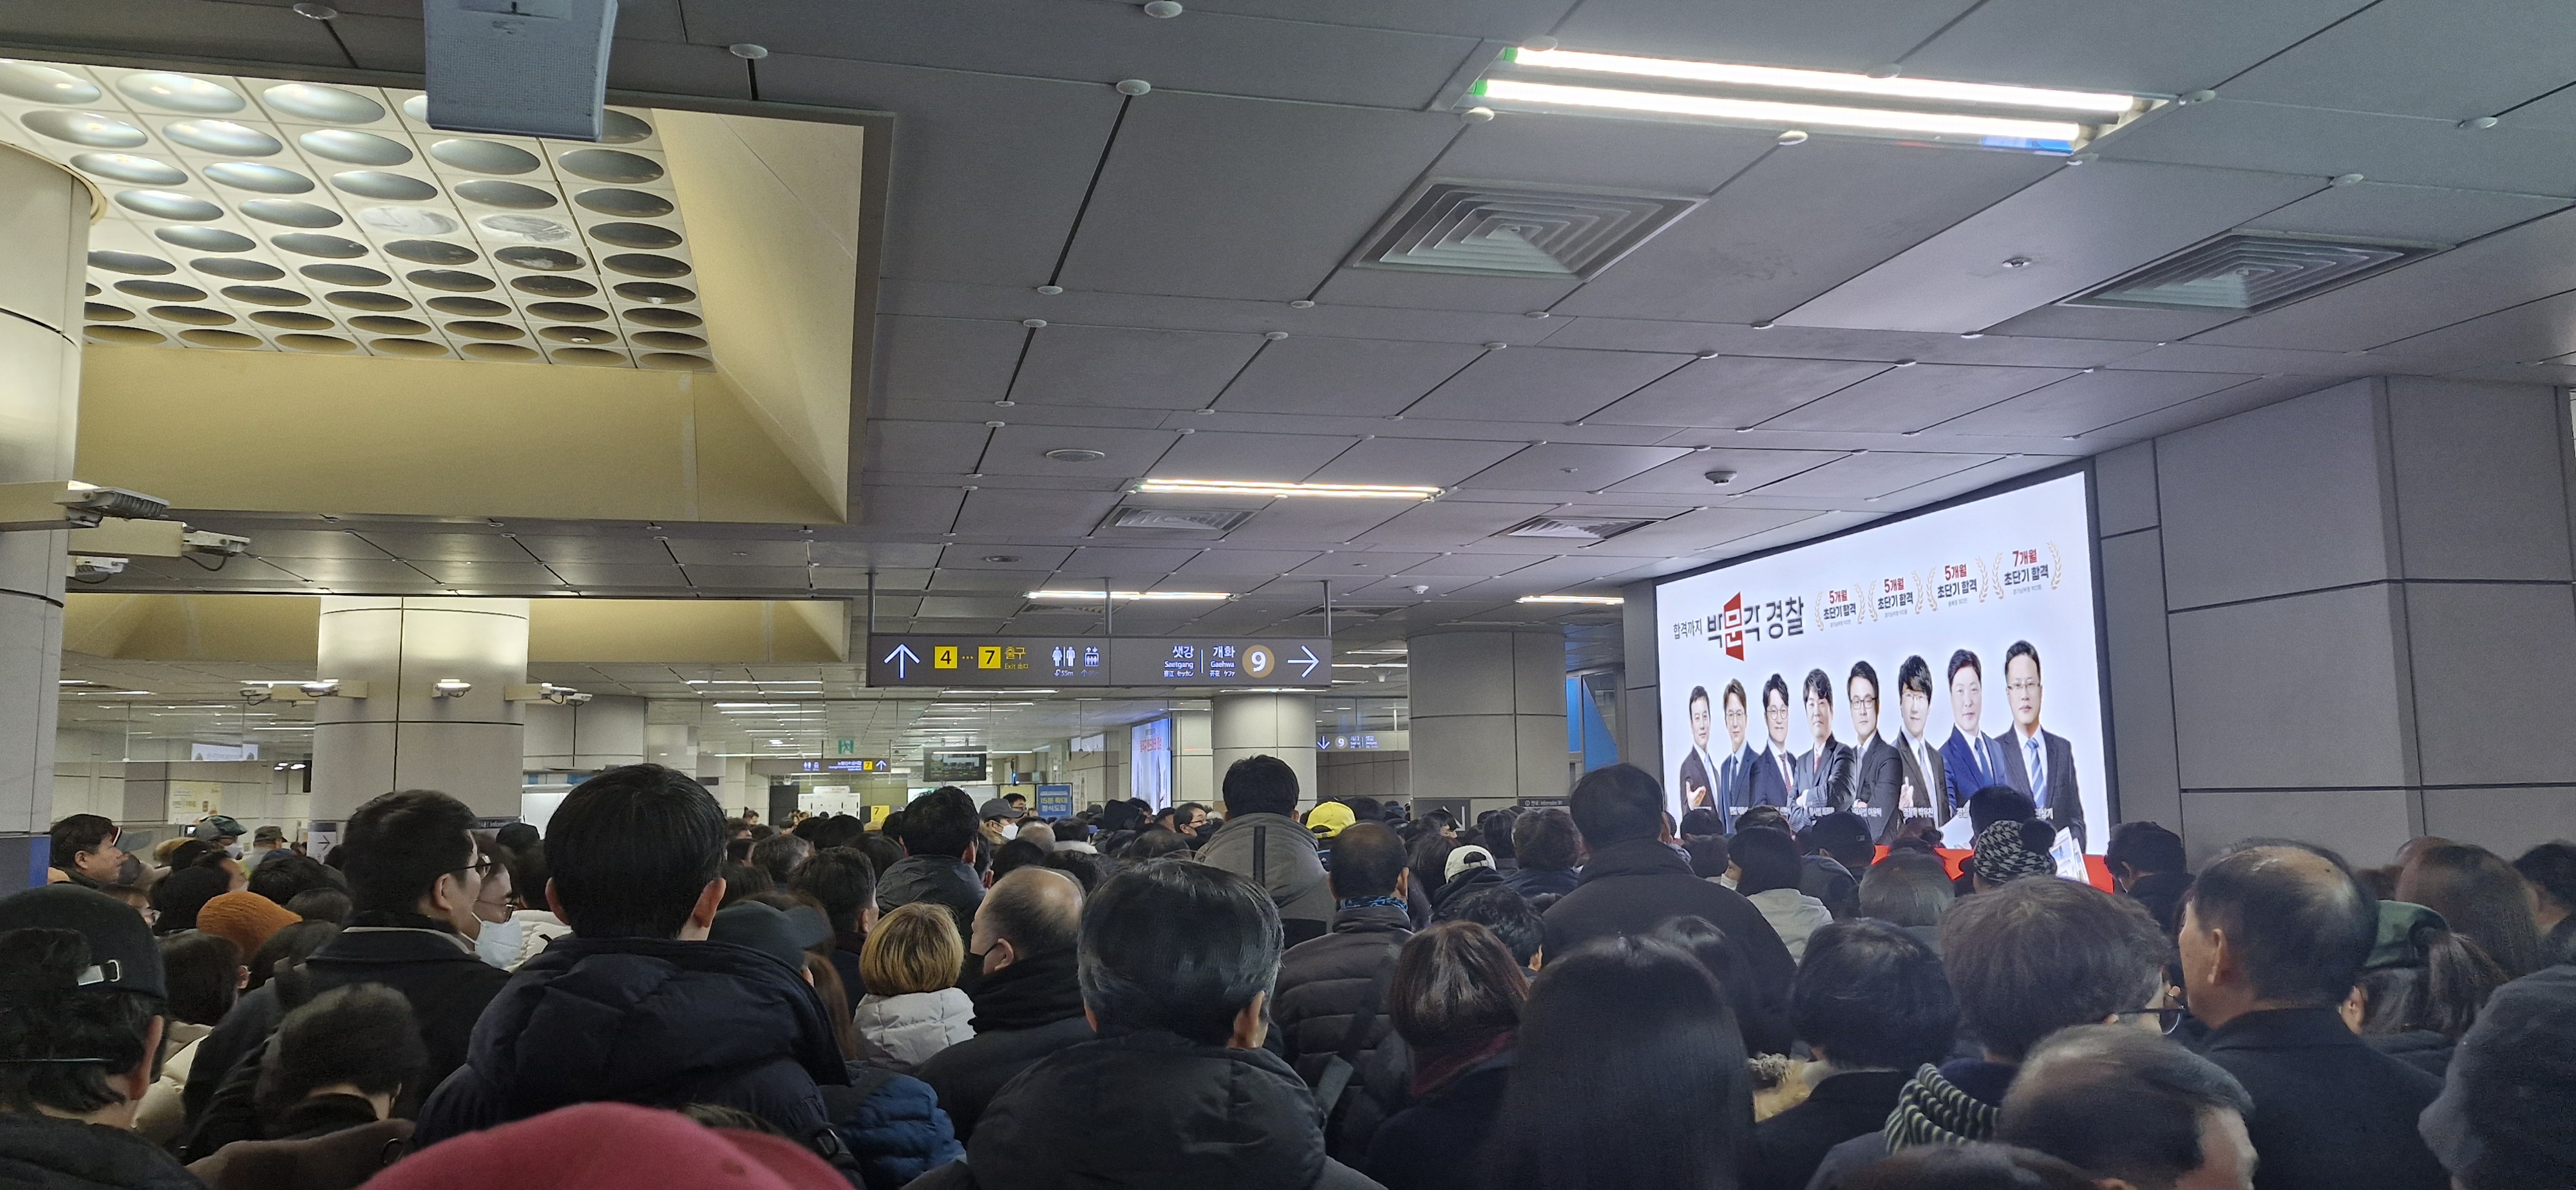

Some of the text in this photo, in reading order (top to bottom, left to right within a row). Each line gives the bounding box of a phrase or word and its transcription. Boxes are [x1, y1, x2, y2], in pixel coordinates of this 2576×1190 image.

[2012, 549, 2037, 567] 7개월
[1945, 563, 1967, 581] 5개월
[2004, 564, 2049, 586] 초단기 합격
[1884, 578, 1904, 593] 5개월
[1937, 578, 1977, 598] 초단기 합격
[1829, 589, 1848, 604] 5개월
[1878, 592, 1913, 610] 초단기 합격
[1823, 603, 1856, 619] 초단기 합격
[1673, 596, 1804, 650] 합격까지 박문각 경찰
[940, 650, 995, 665] 4 7
[1005, 647, 1026, 660] 출구
[1173, 646, 1194, 658] 샛강
[1213, 646, 1235, 658] 개화
[1164, 661, 1194, 669] Saetgang
[1251, 651, 1267, 672] 9
[1338, 738, 1345, 747] 9
[1956, 807, 1969, 818] 경찰
